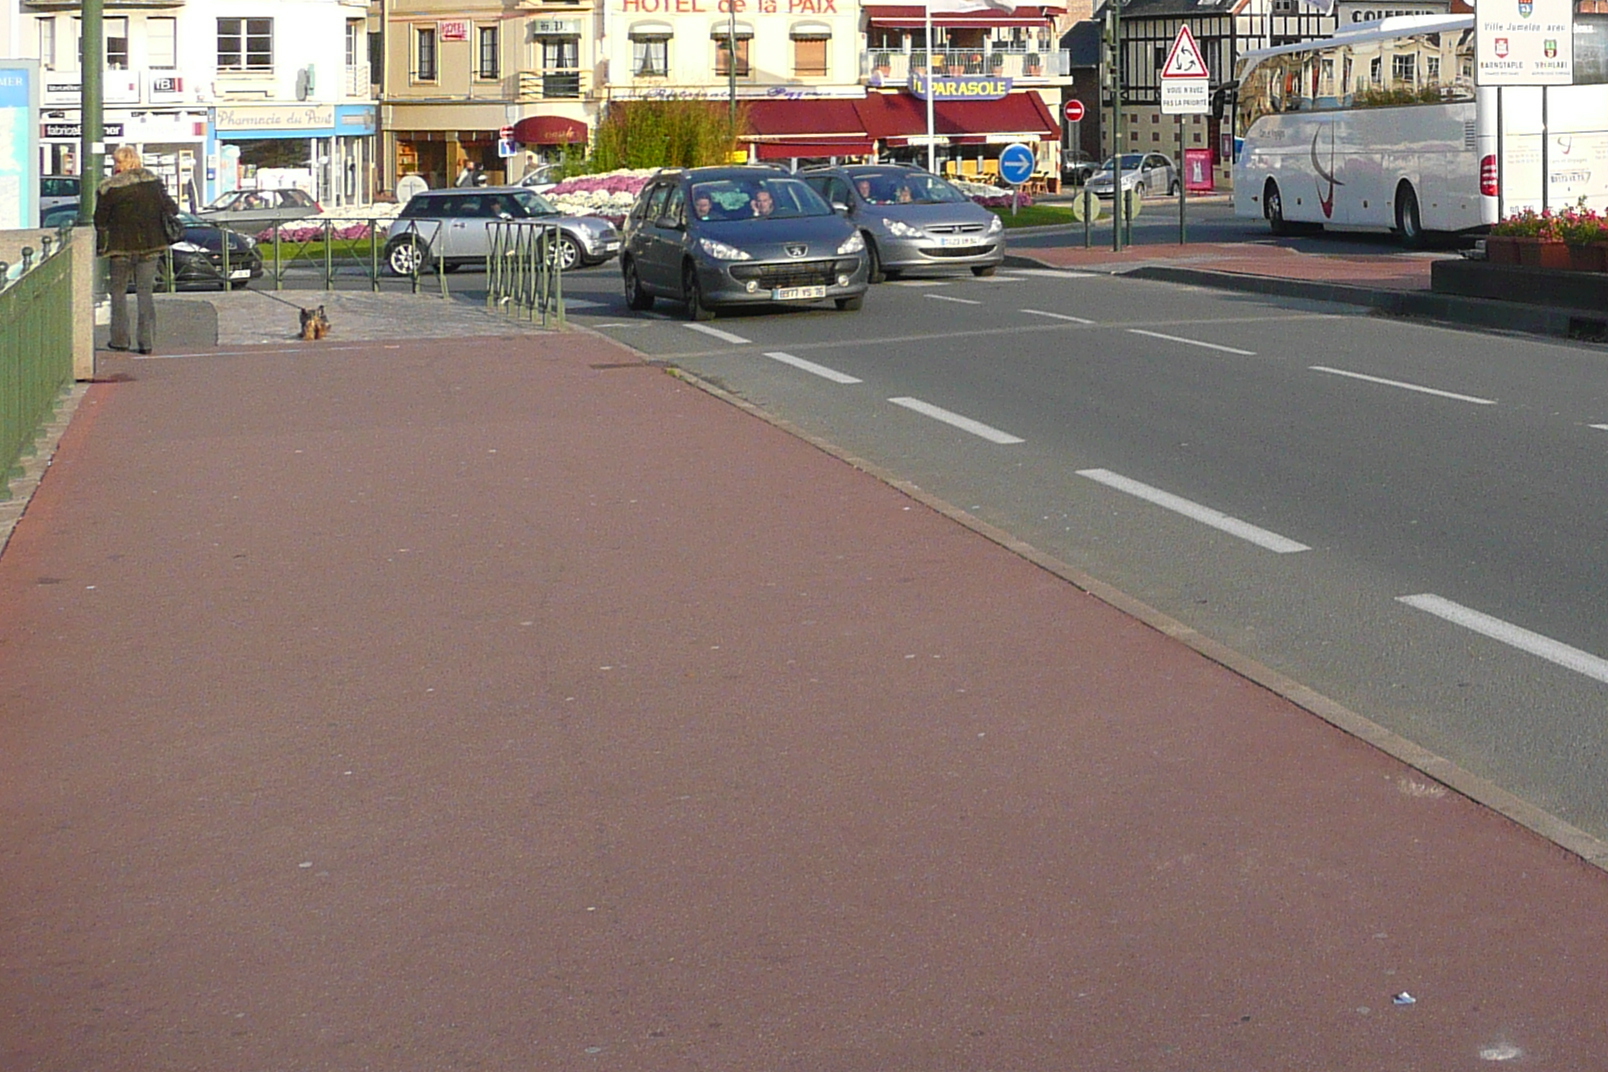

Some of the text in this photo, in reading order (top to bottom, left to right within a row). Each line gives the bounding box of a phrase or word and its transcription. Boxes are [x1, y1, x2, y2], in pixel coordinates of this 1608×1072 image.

[440, 22, 467, 32] HOTEL
[931, 80, 1006, 96] PARASOLE
[217, 108, 332, 126] Pharmacie du Pont
